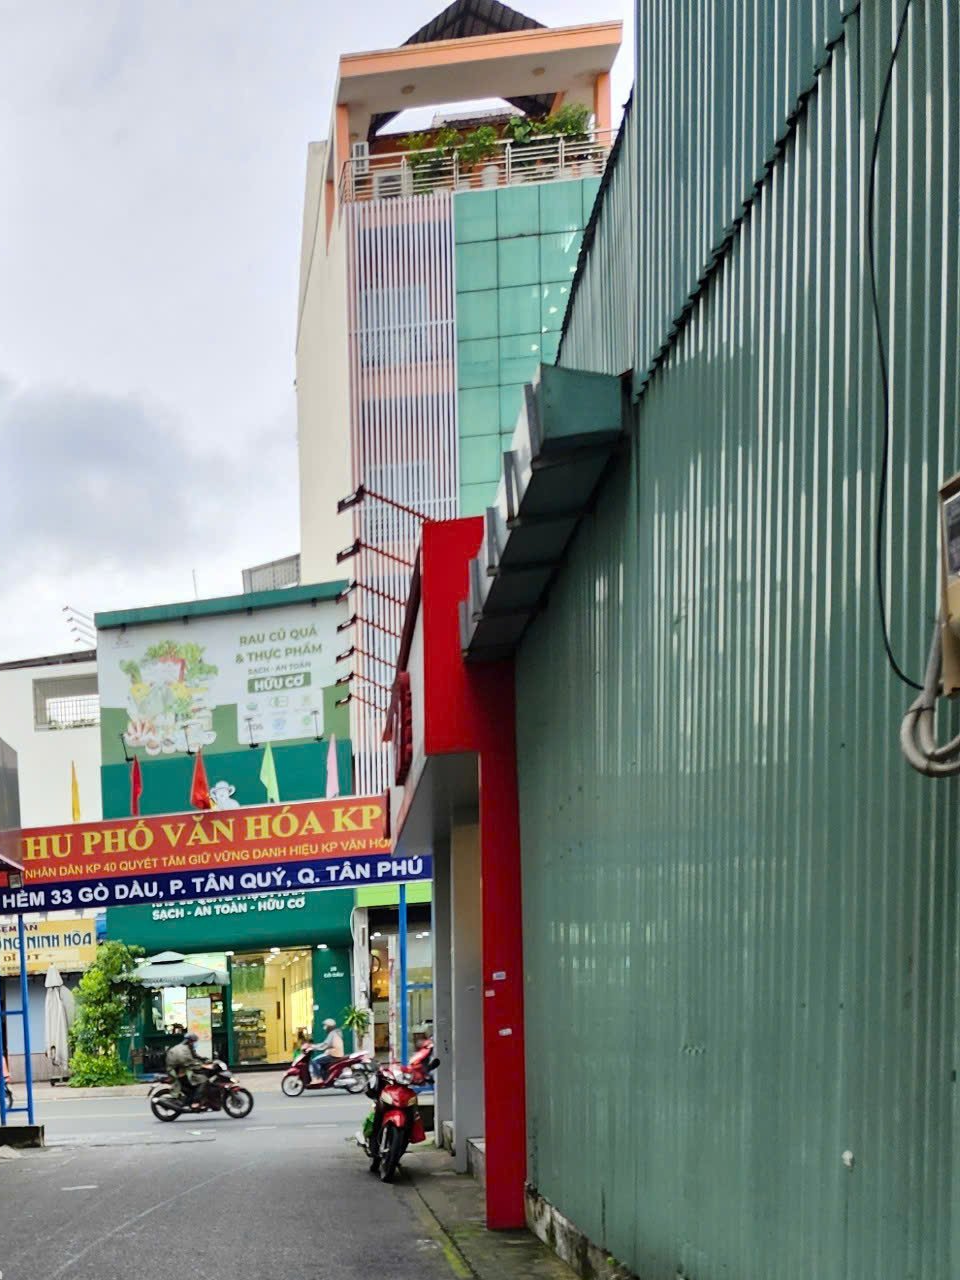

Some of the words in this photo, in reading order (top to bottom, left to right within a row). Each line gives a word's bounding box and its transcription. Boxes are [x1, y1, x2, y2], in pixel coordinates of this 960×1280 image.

[239, 632, 266, 647] RAU
[23, 832, 73, 861] HU
[82, 820, 154, 856] PHỐ
[161, 815, 236, 848] VĂN
[244, 805, 326, 841] HÓA
[331, 804, 383, 833] KP
[86, 863, 101, 875] KP
[103, 862, 117, 873] 40
[252, 845, 287, 860] DANH
[289, 842, 319, 857] HIỆU
[321, 841, 338, 853] KP
[51, 888, 73, 905] 33
[78, 882, 110, 903] GÒ
[169, 879, 186, 896] P.
[191, 872, 234, 893] TÂN
[239, 867, 292, 889] QUÝ,
[297, 868, 320, 885] Q.
[325, 860, 371, 882] TÂN
[376, 855, 424, 879] PHÚ
[151, 906, 184, 921] SẠCH
[194, 904, 212, 917] AN
[214, 901, 248, 916] TOÀN
[287, 896, 306, 909] CƠ
[26, 934, 60, 949] NINH
